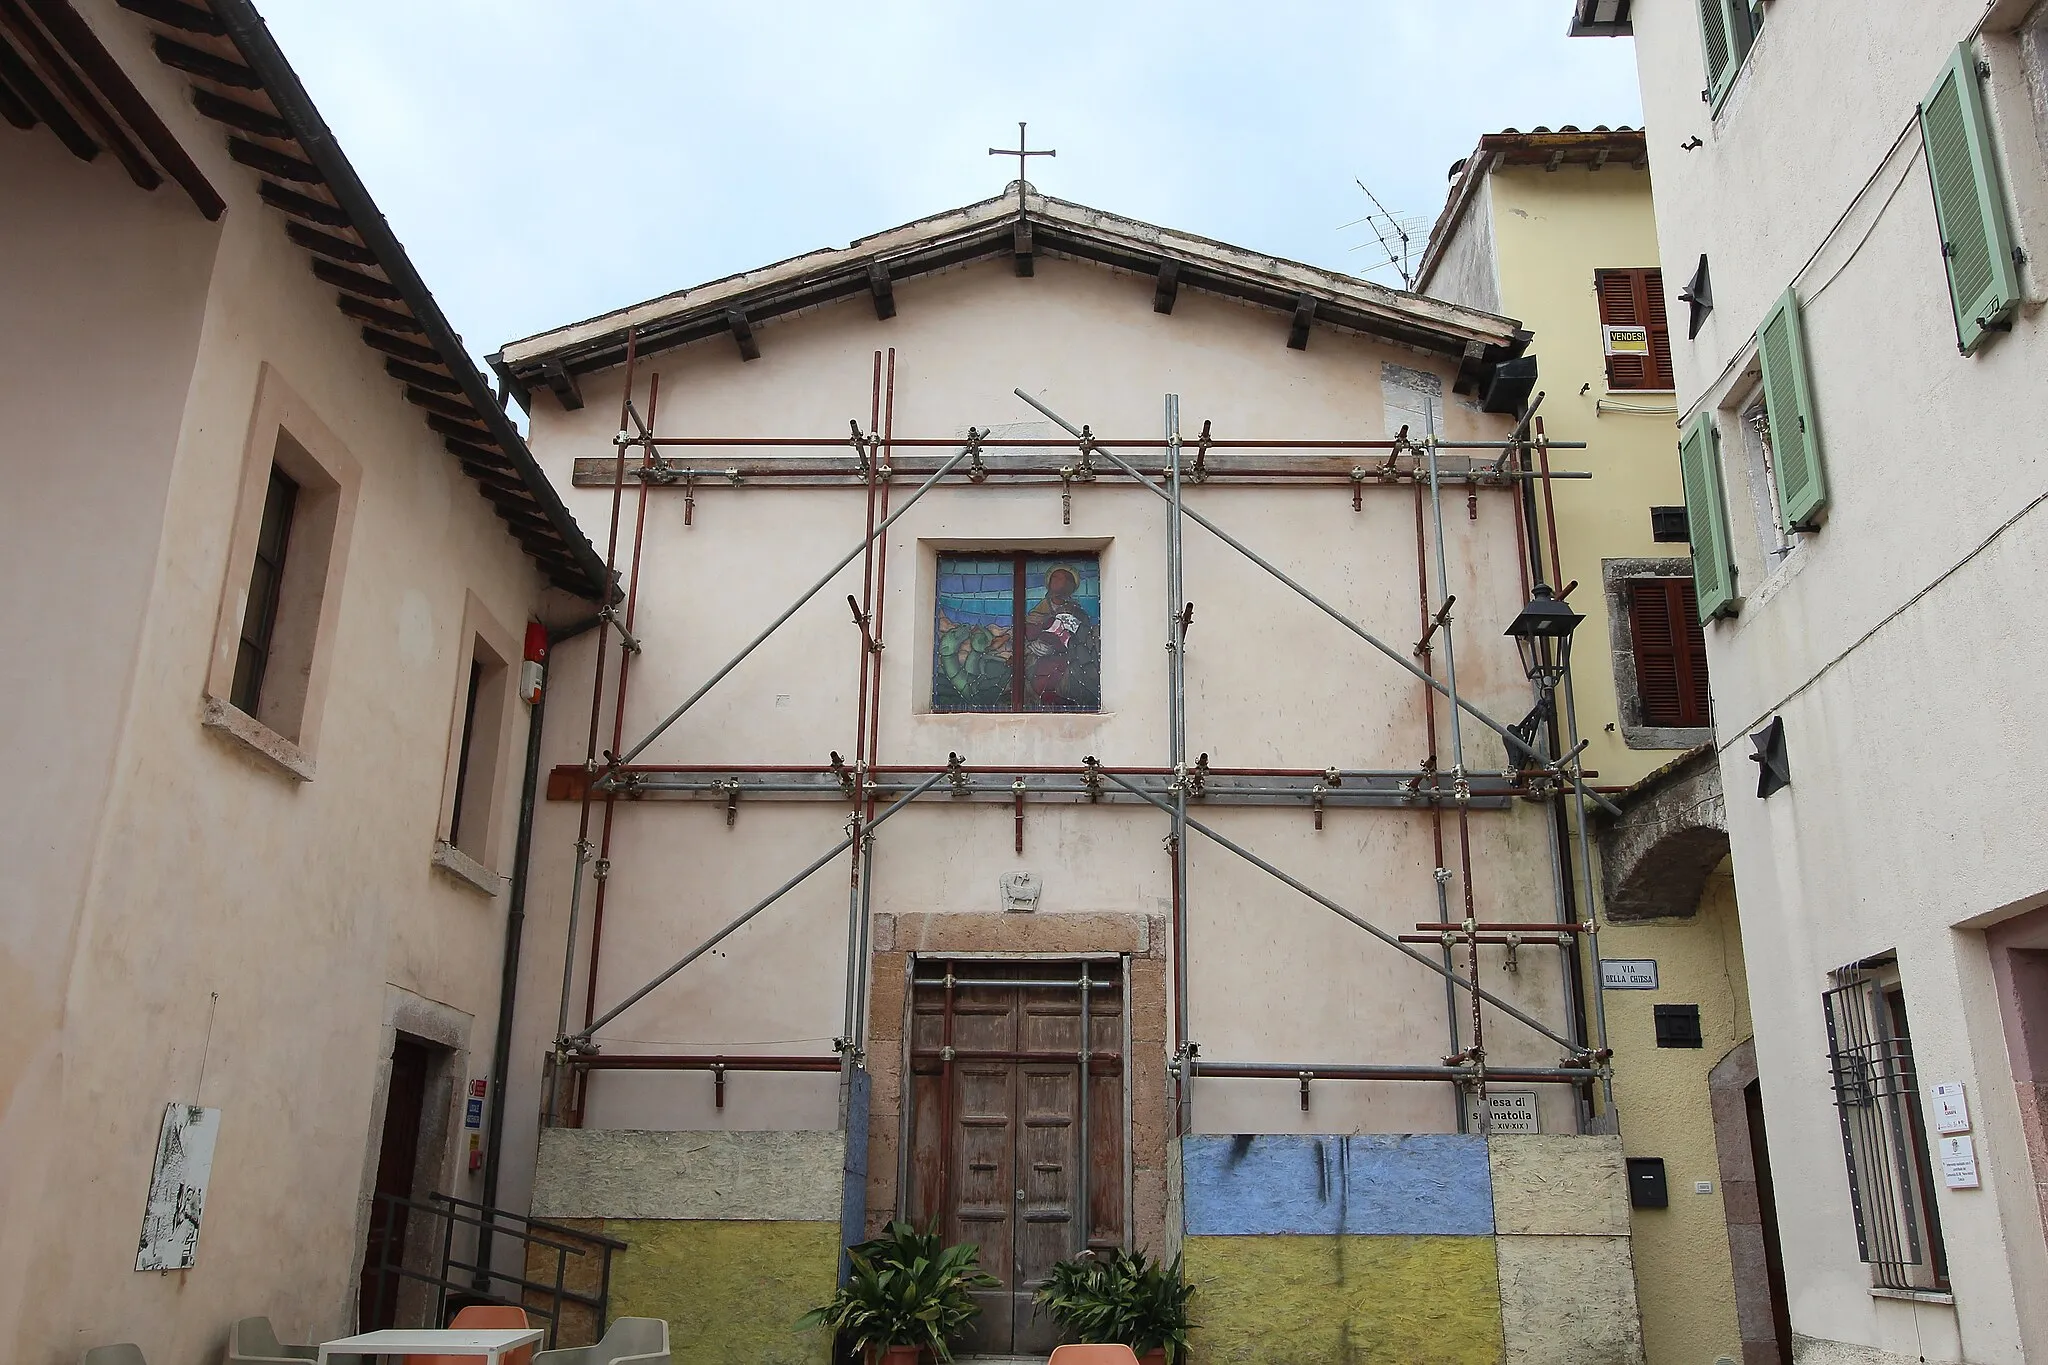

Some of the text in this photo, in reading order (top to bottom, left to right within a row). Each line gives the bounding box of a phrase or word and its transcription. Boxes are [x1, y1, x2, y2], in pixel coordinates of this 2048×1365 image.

[1611, 332, 1645, 341] VENDESI
[1621, 965, 1636, 973] VIA
[1605, 975, 1653, 983] DELLA CHIESA
[1477, 1097, 1525, 1107] iesa di
